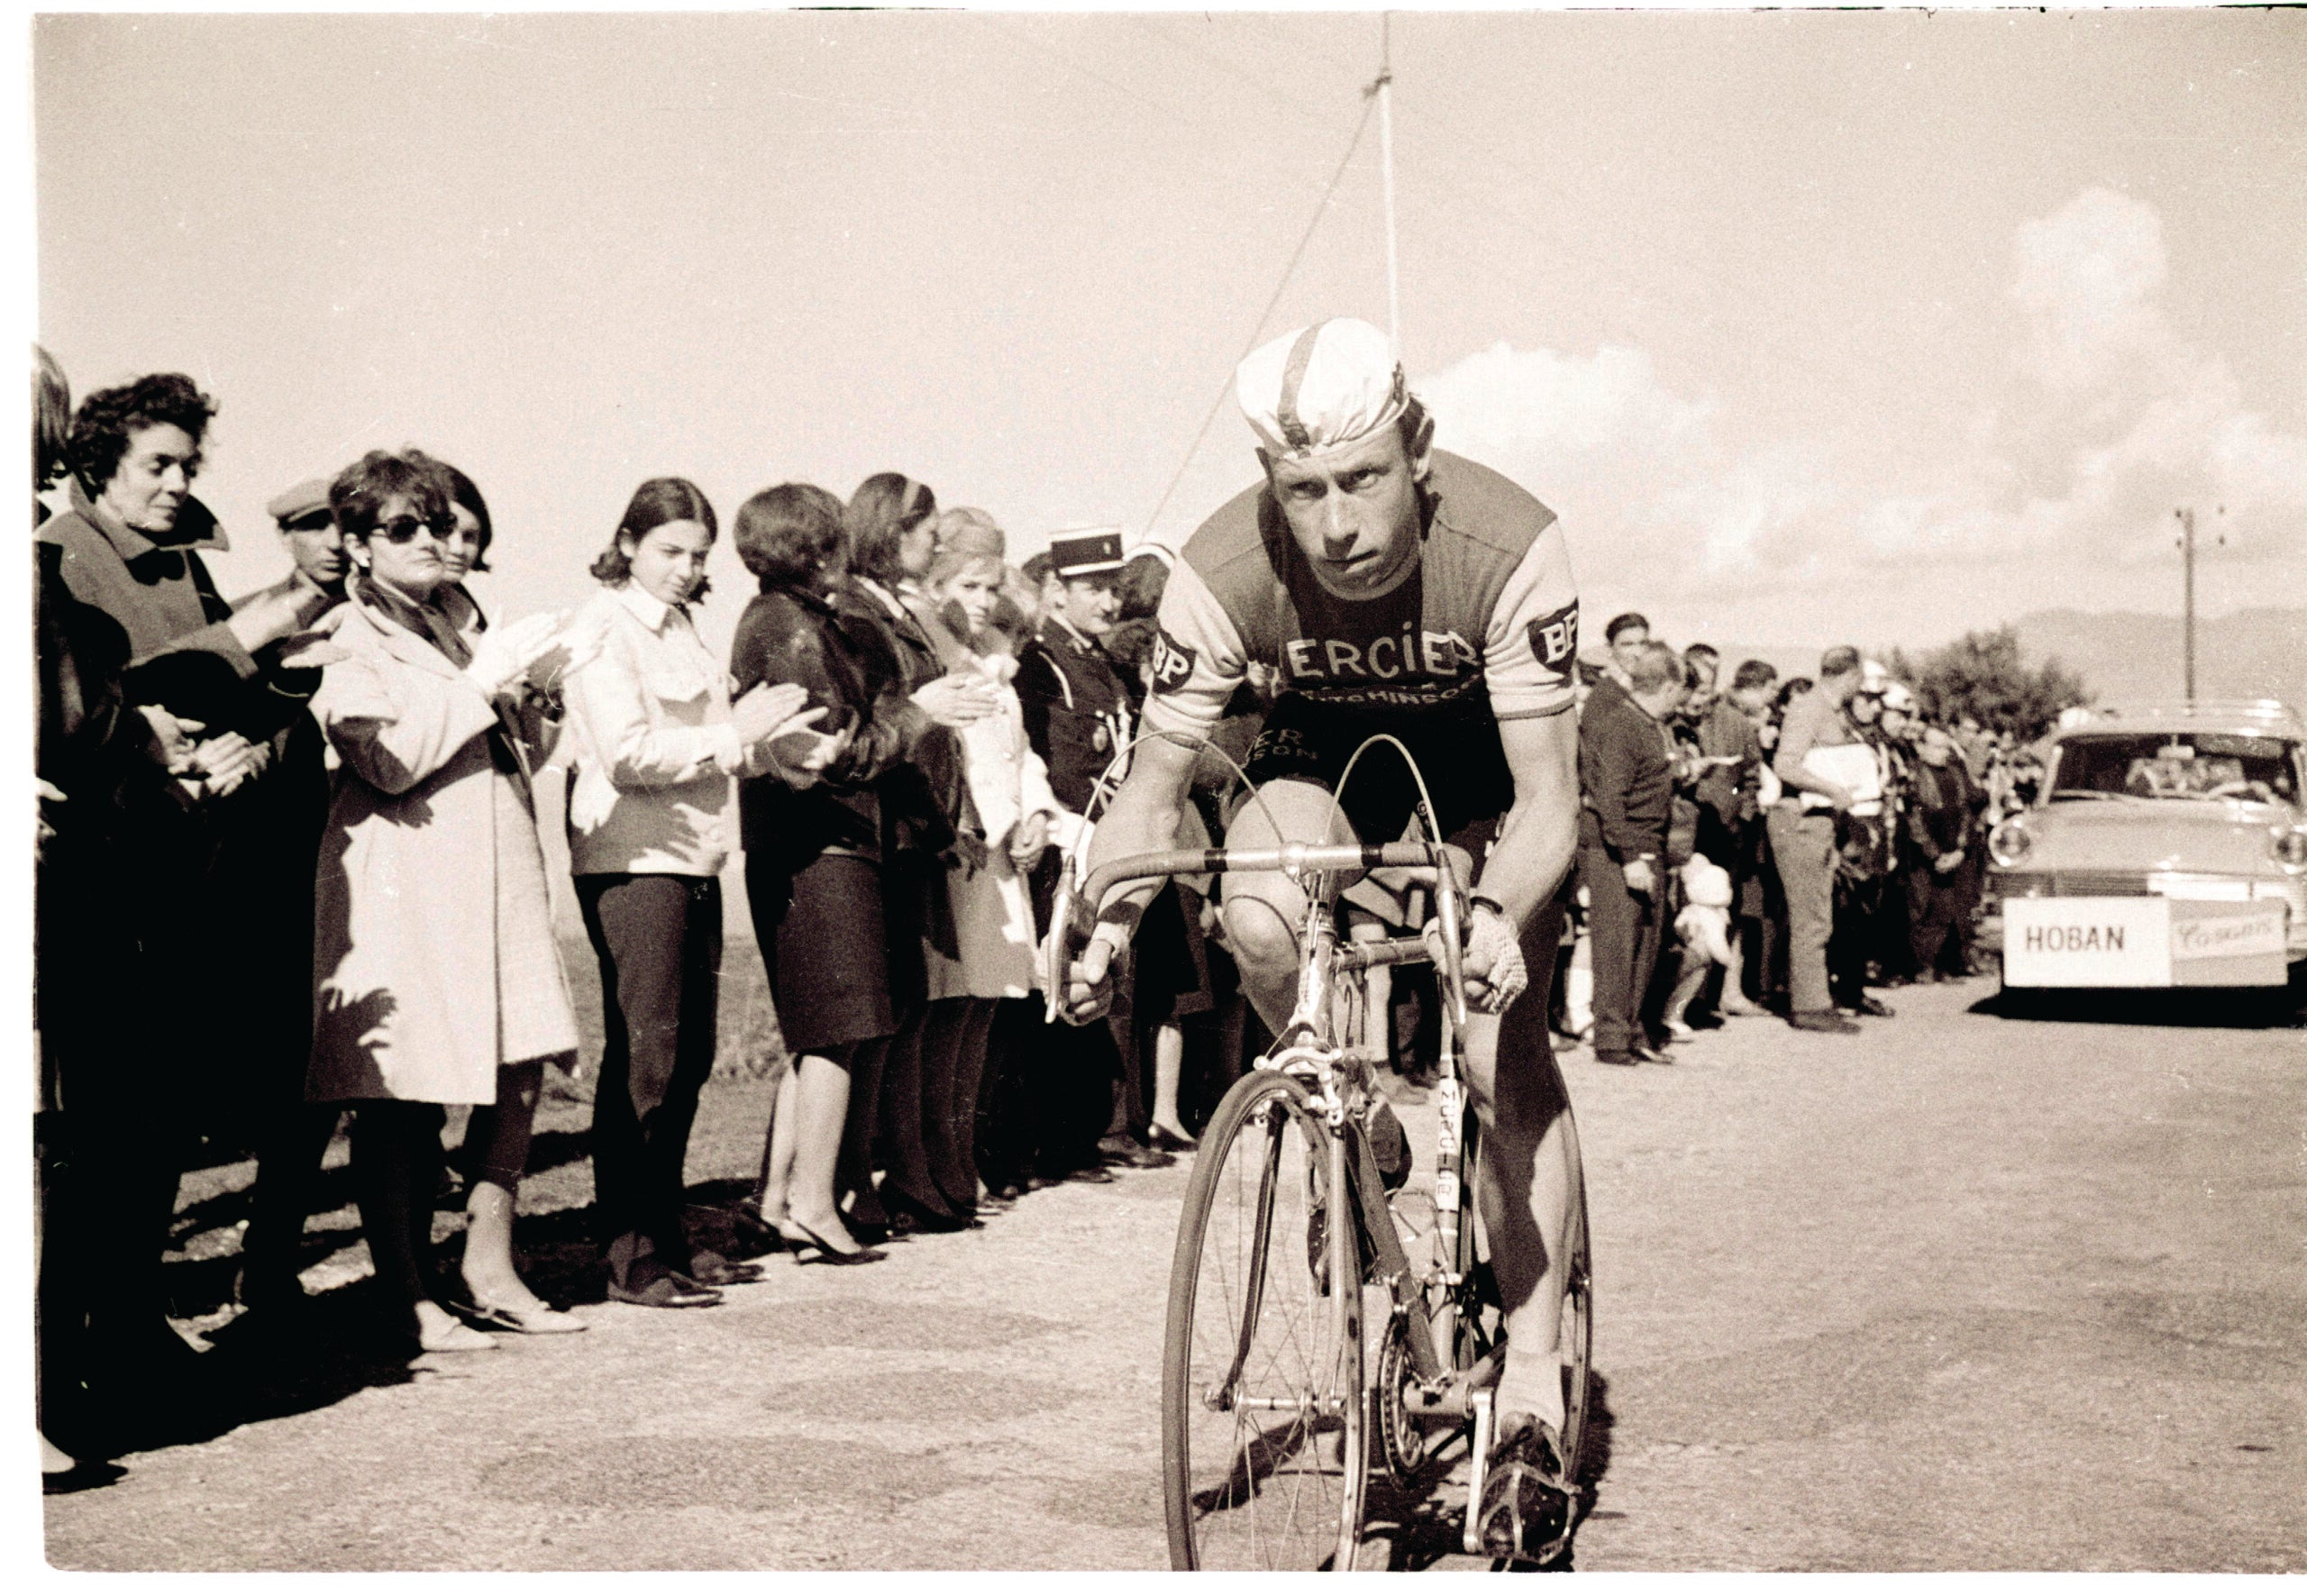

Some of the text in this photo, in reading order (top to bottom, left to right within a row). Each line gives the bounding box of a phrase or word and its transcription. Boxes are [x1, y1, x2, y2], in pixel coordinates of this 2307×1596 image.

[1154, 632, 1190, 685] BP
[1538, 609, 1578, 664] BP
[2027, 926, 2125, 952] HOBAN
